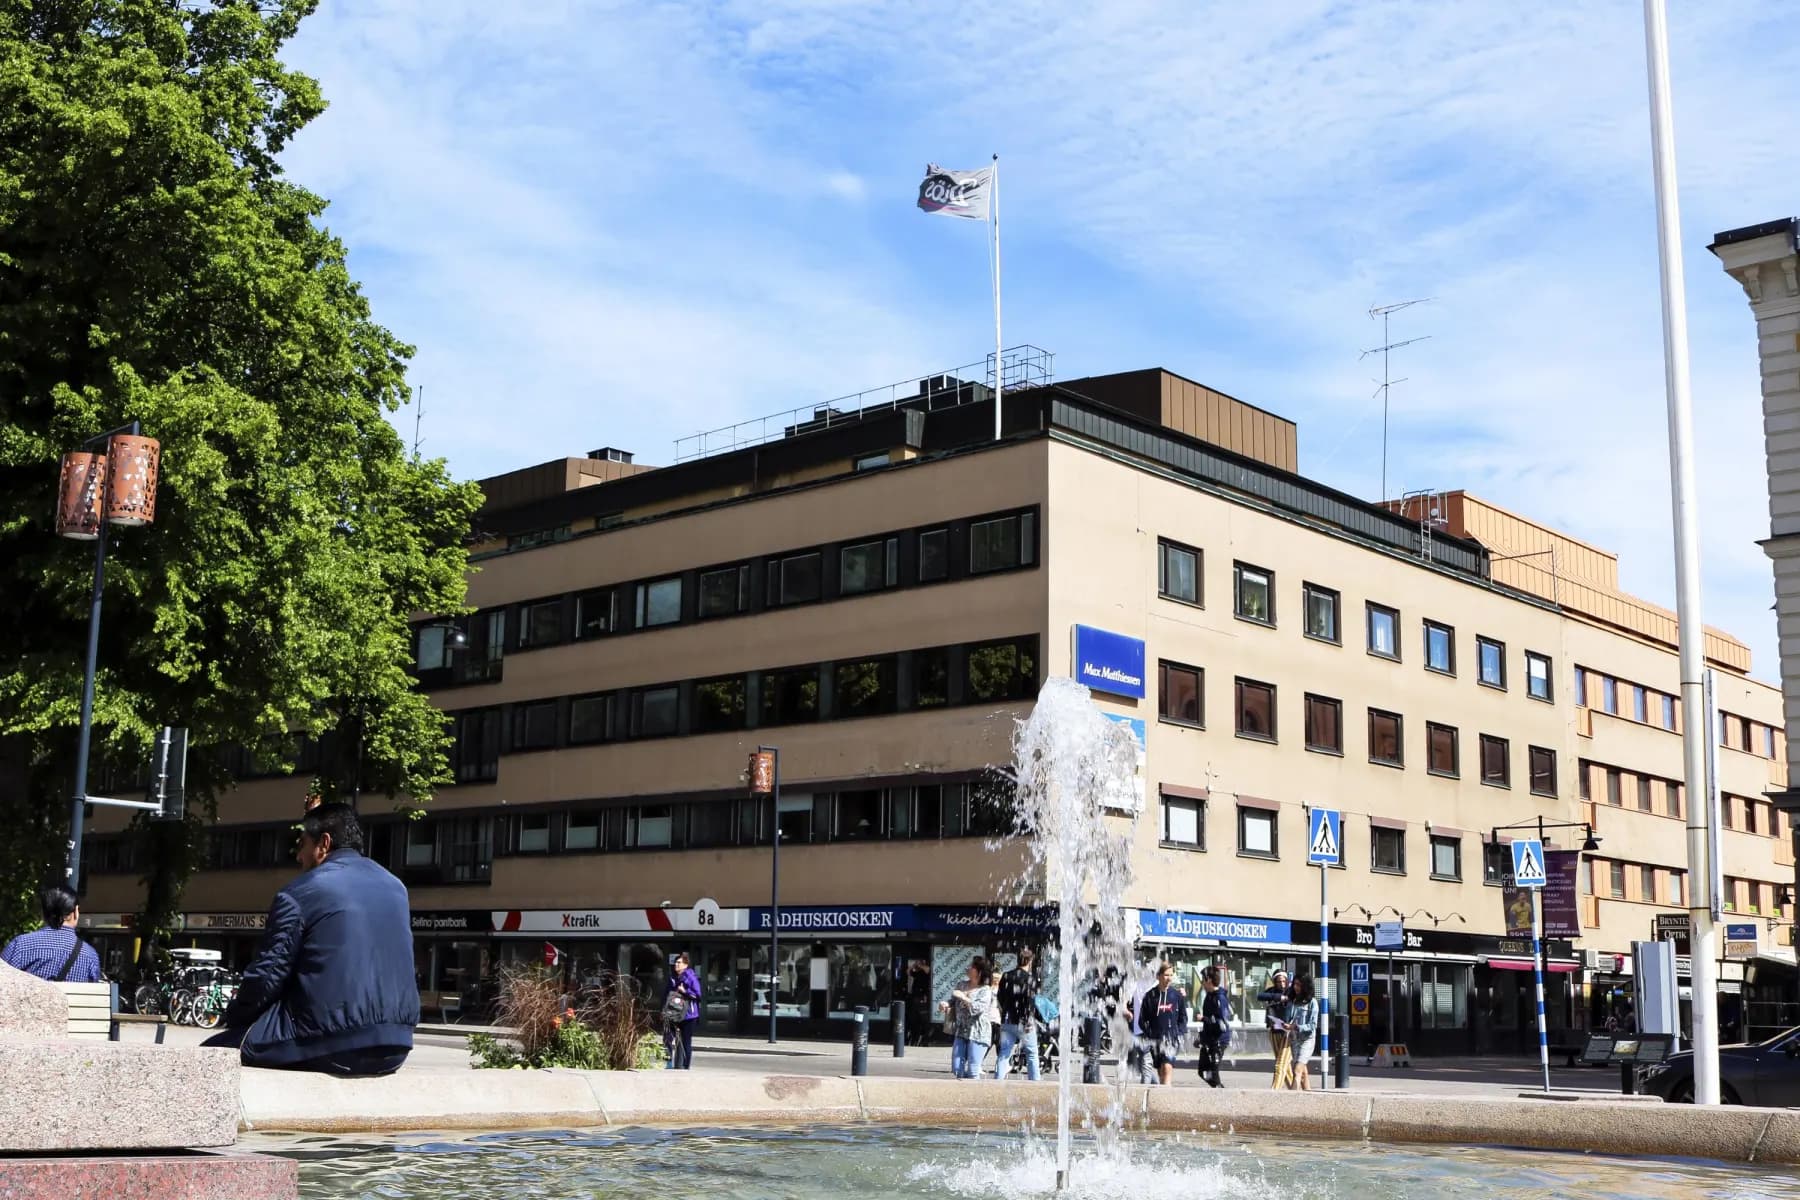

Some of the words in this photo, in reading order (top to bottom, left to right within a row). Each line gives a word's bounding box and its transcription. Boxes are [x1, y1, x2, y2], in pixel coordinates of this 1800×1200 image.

[1083, 662, 1101, 676] Max
[1101, 666, 1141, 687] Matthiessen
[207, 915, 256, 928] ZIMMERMANS
[562, 913, 600, 928] Xtrafik
[1166, 914, 1268, 939] RÅDHUSKIOSKEN
[1407, 932, 1423, 947] Bar
